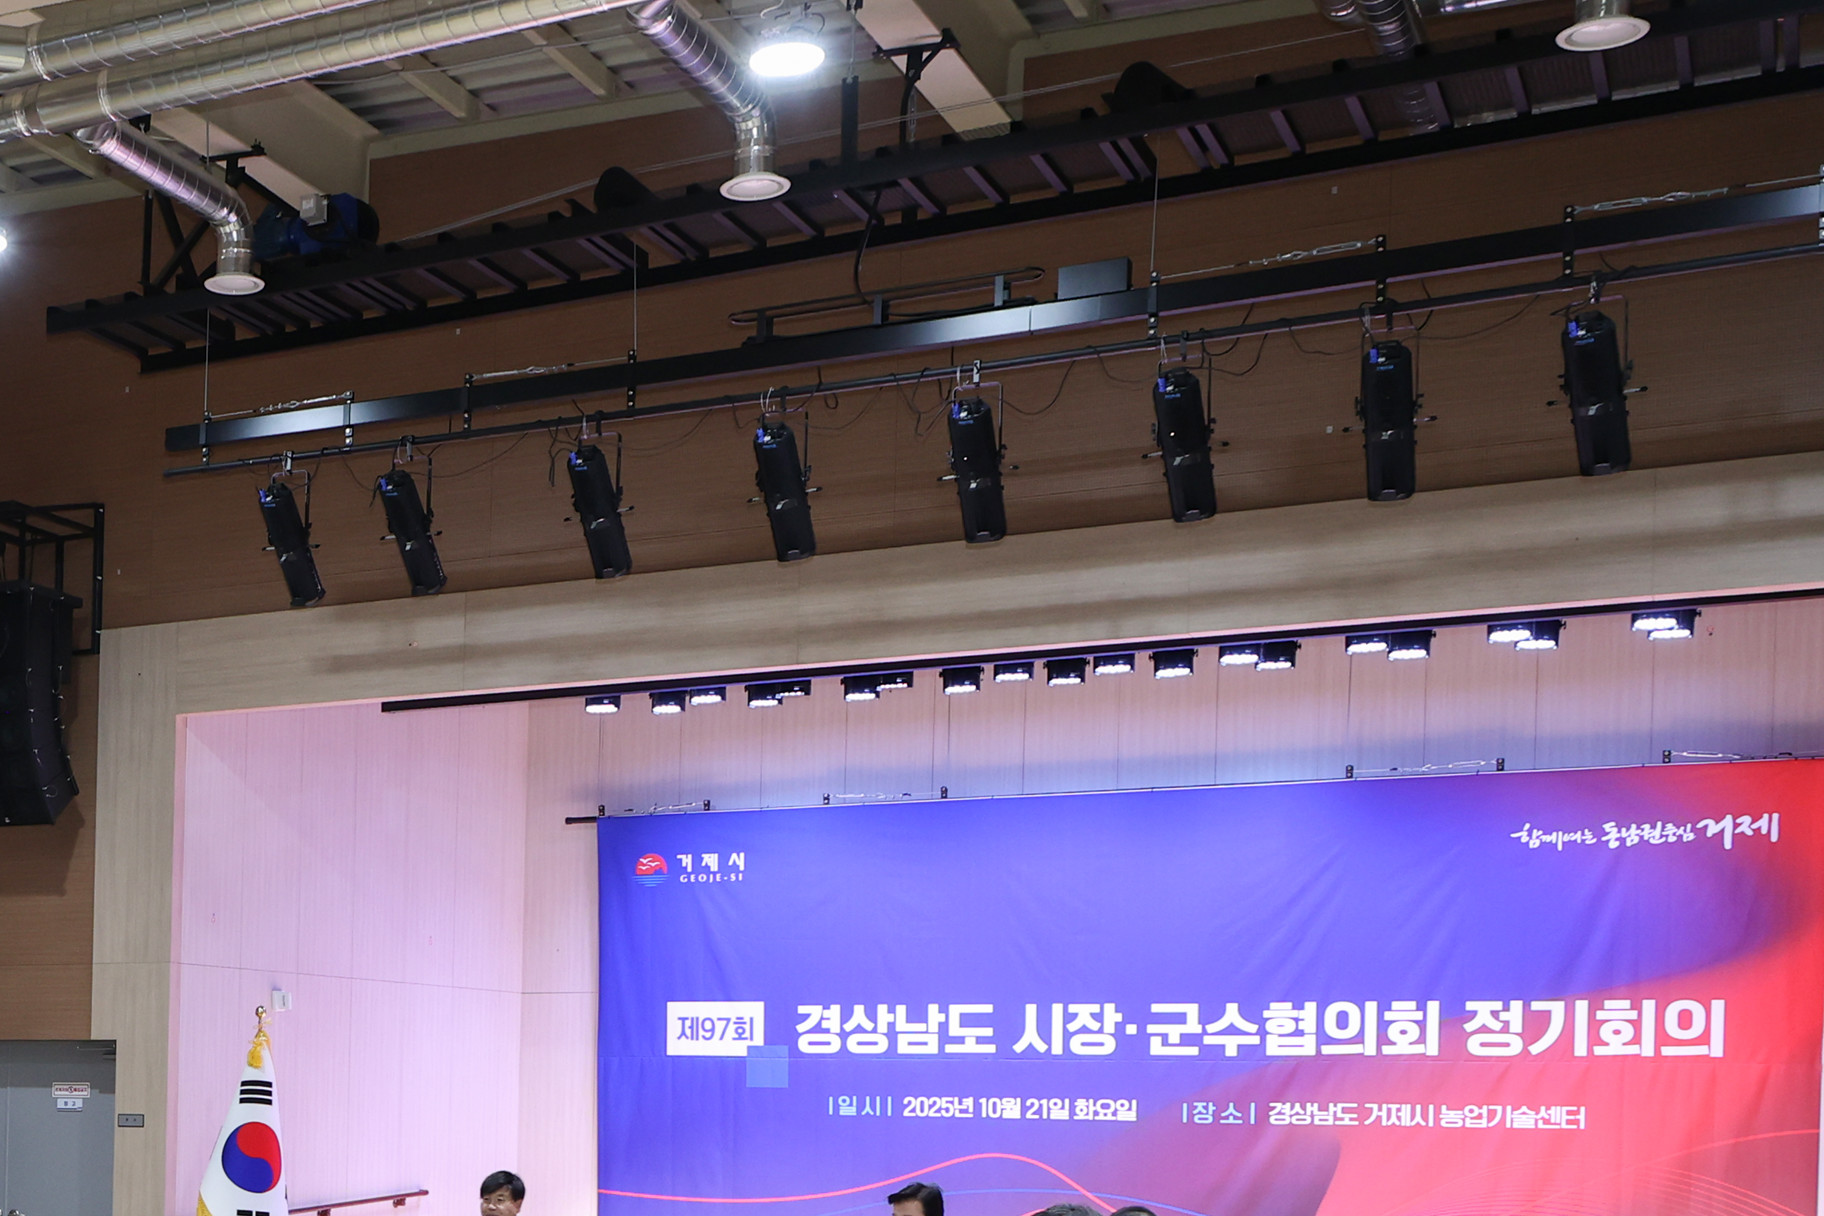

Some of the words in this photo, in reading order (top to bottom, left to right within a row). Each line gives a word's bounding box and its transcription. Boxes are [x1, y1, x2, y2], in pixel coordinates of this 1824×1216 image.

[1695, 812, 1780, 850] 거제
[676, 851, 746, 873] 거제시
[679, 872, 744, 883] GEOJE-SI
[676, 1016, 755, 1042] 제97회
[795, 1002, 998, 1055] 경상남도
[1011, 999, 1440, 1058] 시장·군수협의회
[1461, 998, 1726, 1059] 정기회의
[902, 1096, 975, 1118] 2025년
[978, 1097, 1022, 1119] 10월
[1025, 1098, 1071, 1120] 21일
[1073, 1098, 1138, 1122] 화요일
[1267, 1102, 1360, 1126] 경상남도
[1363, 1103, 1436, 1128] 거제시
[1438, 1103, 1587, 1130] 농업기술센터
